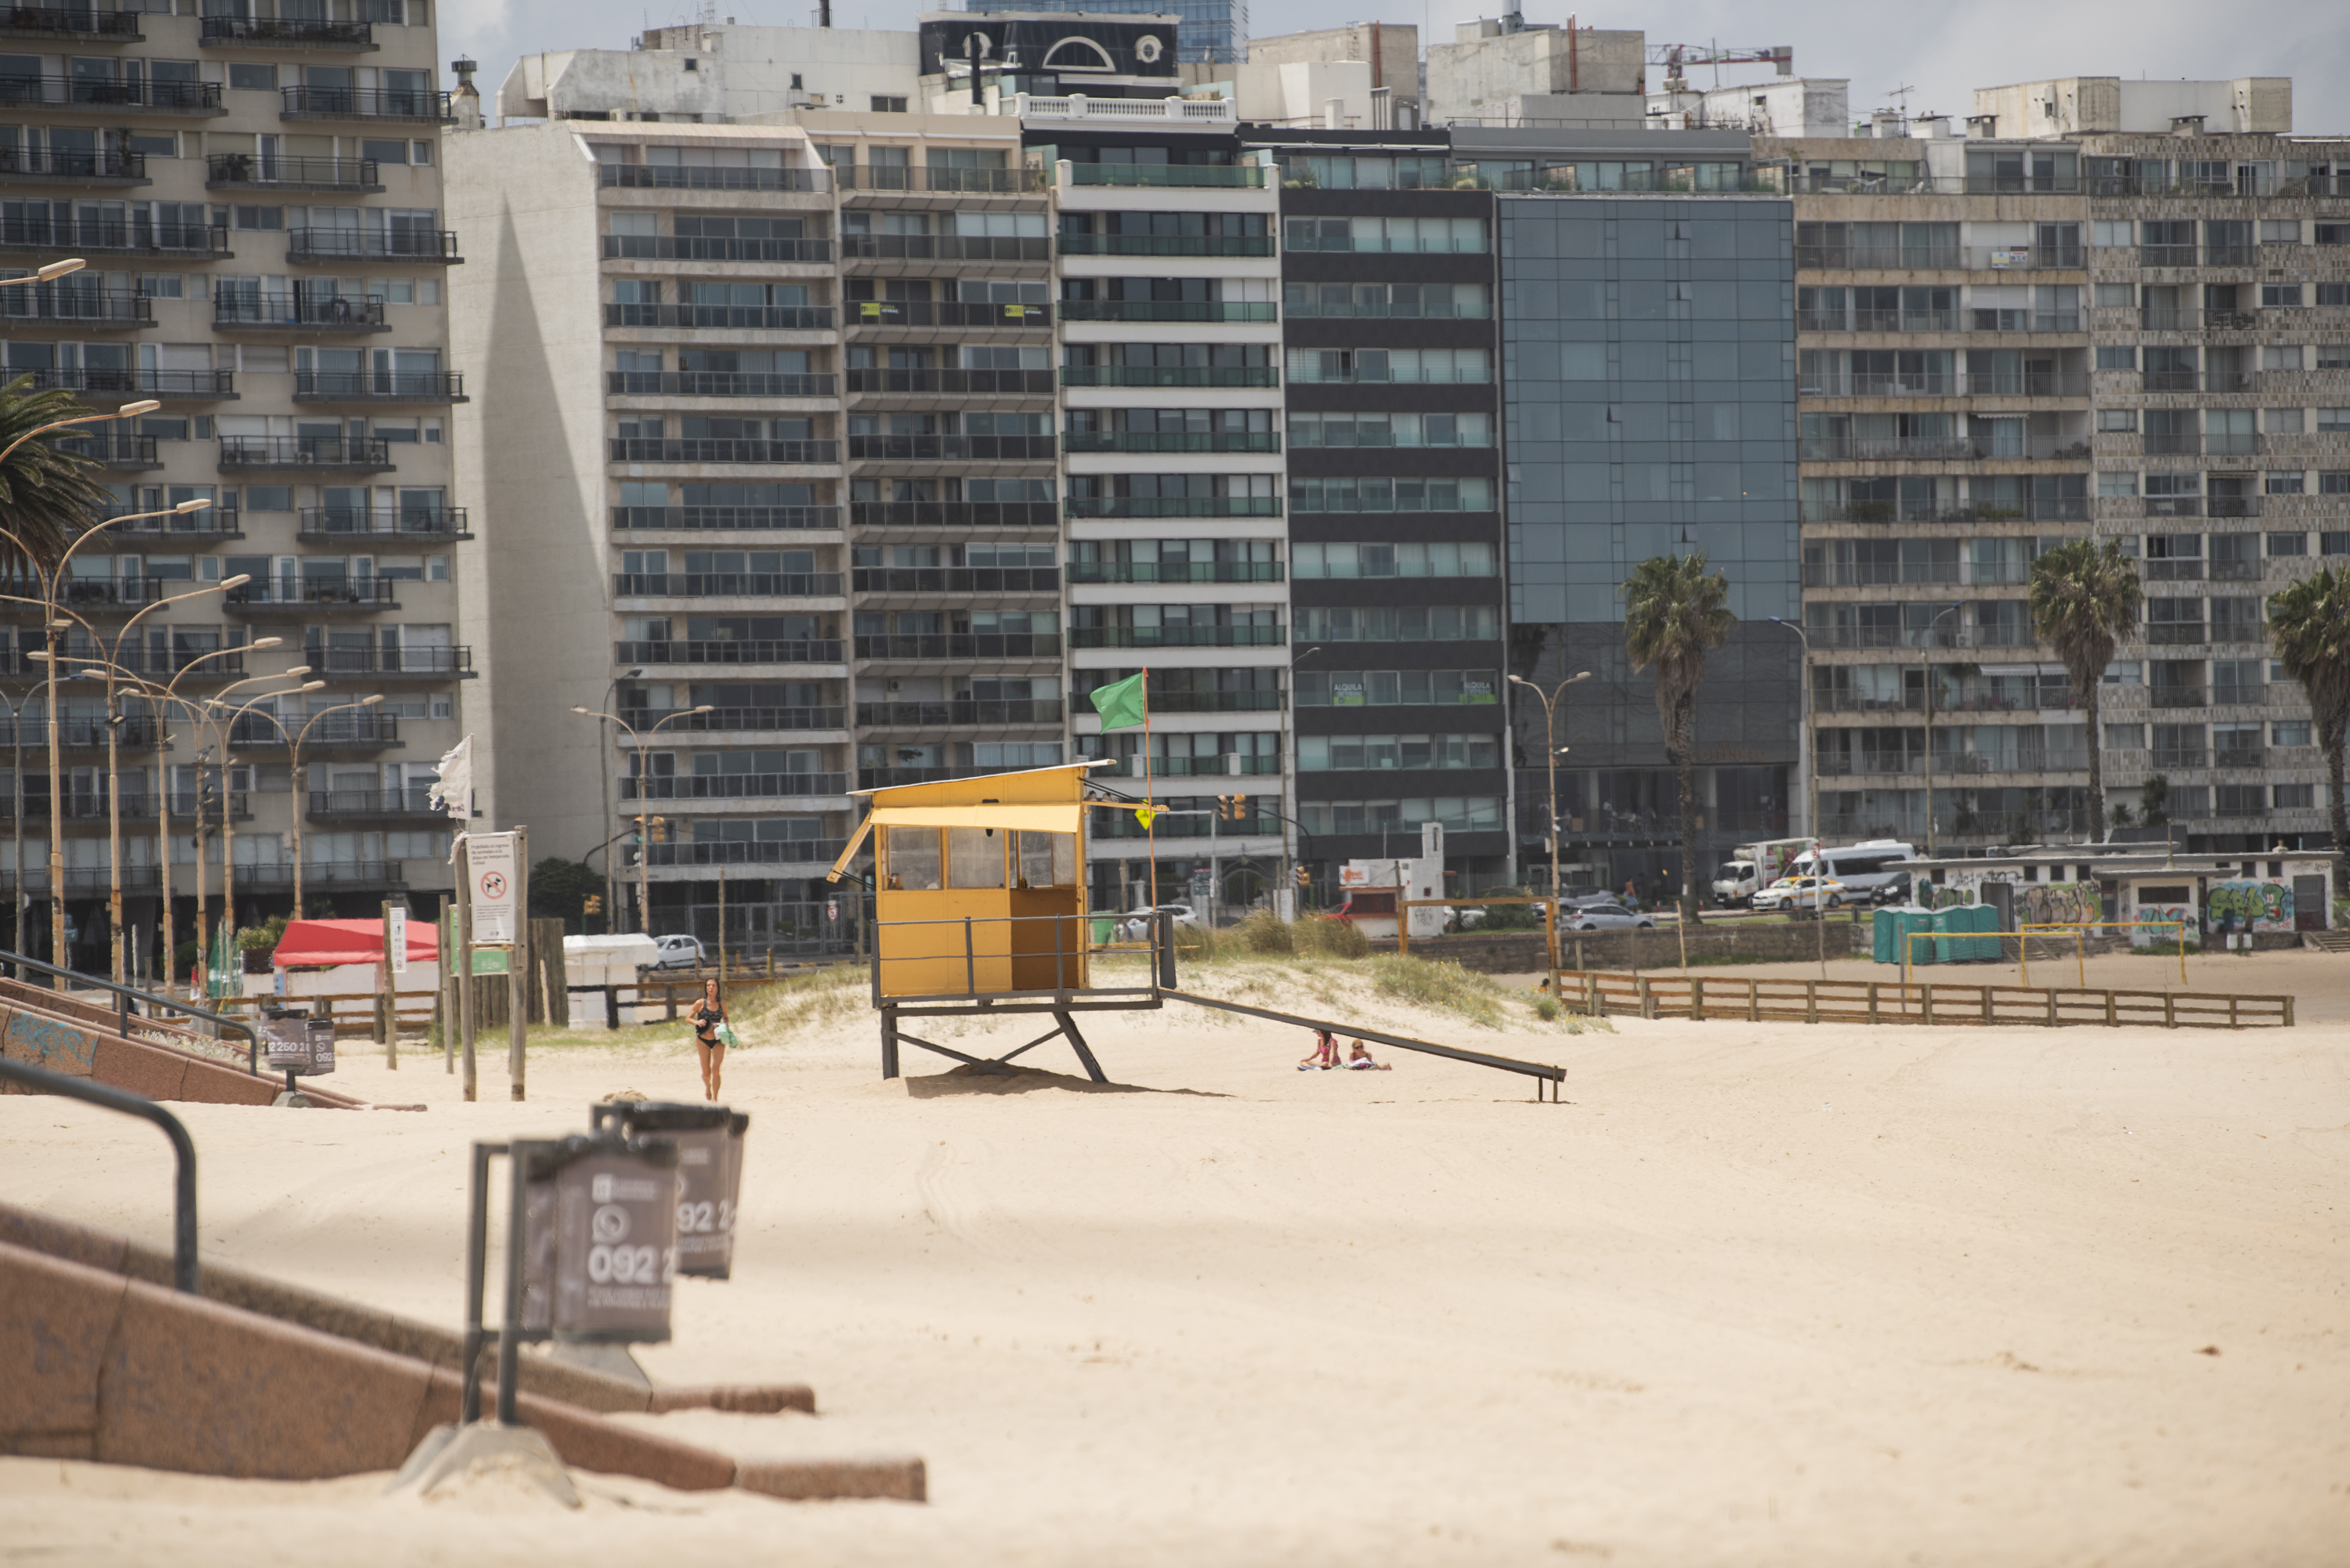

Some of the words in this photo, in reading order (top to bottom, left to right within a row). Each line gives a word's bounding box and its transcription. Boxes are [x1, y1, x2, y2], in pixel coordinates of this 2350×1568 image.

[1334, 683, 1362, 692] ALQUILA
[277, 1042, 297, 1052] 250
[316, 1053, 332, 1062] 092
[588, 1245, 657, 1284] 092
